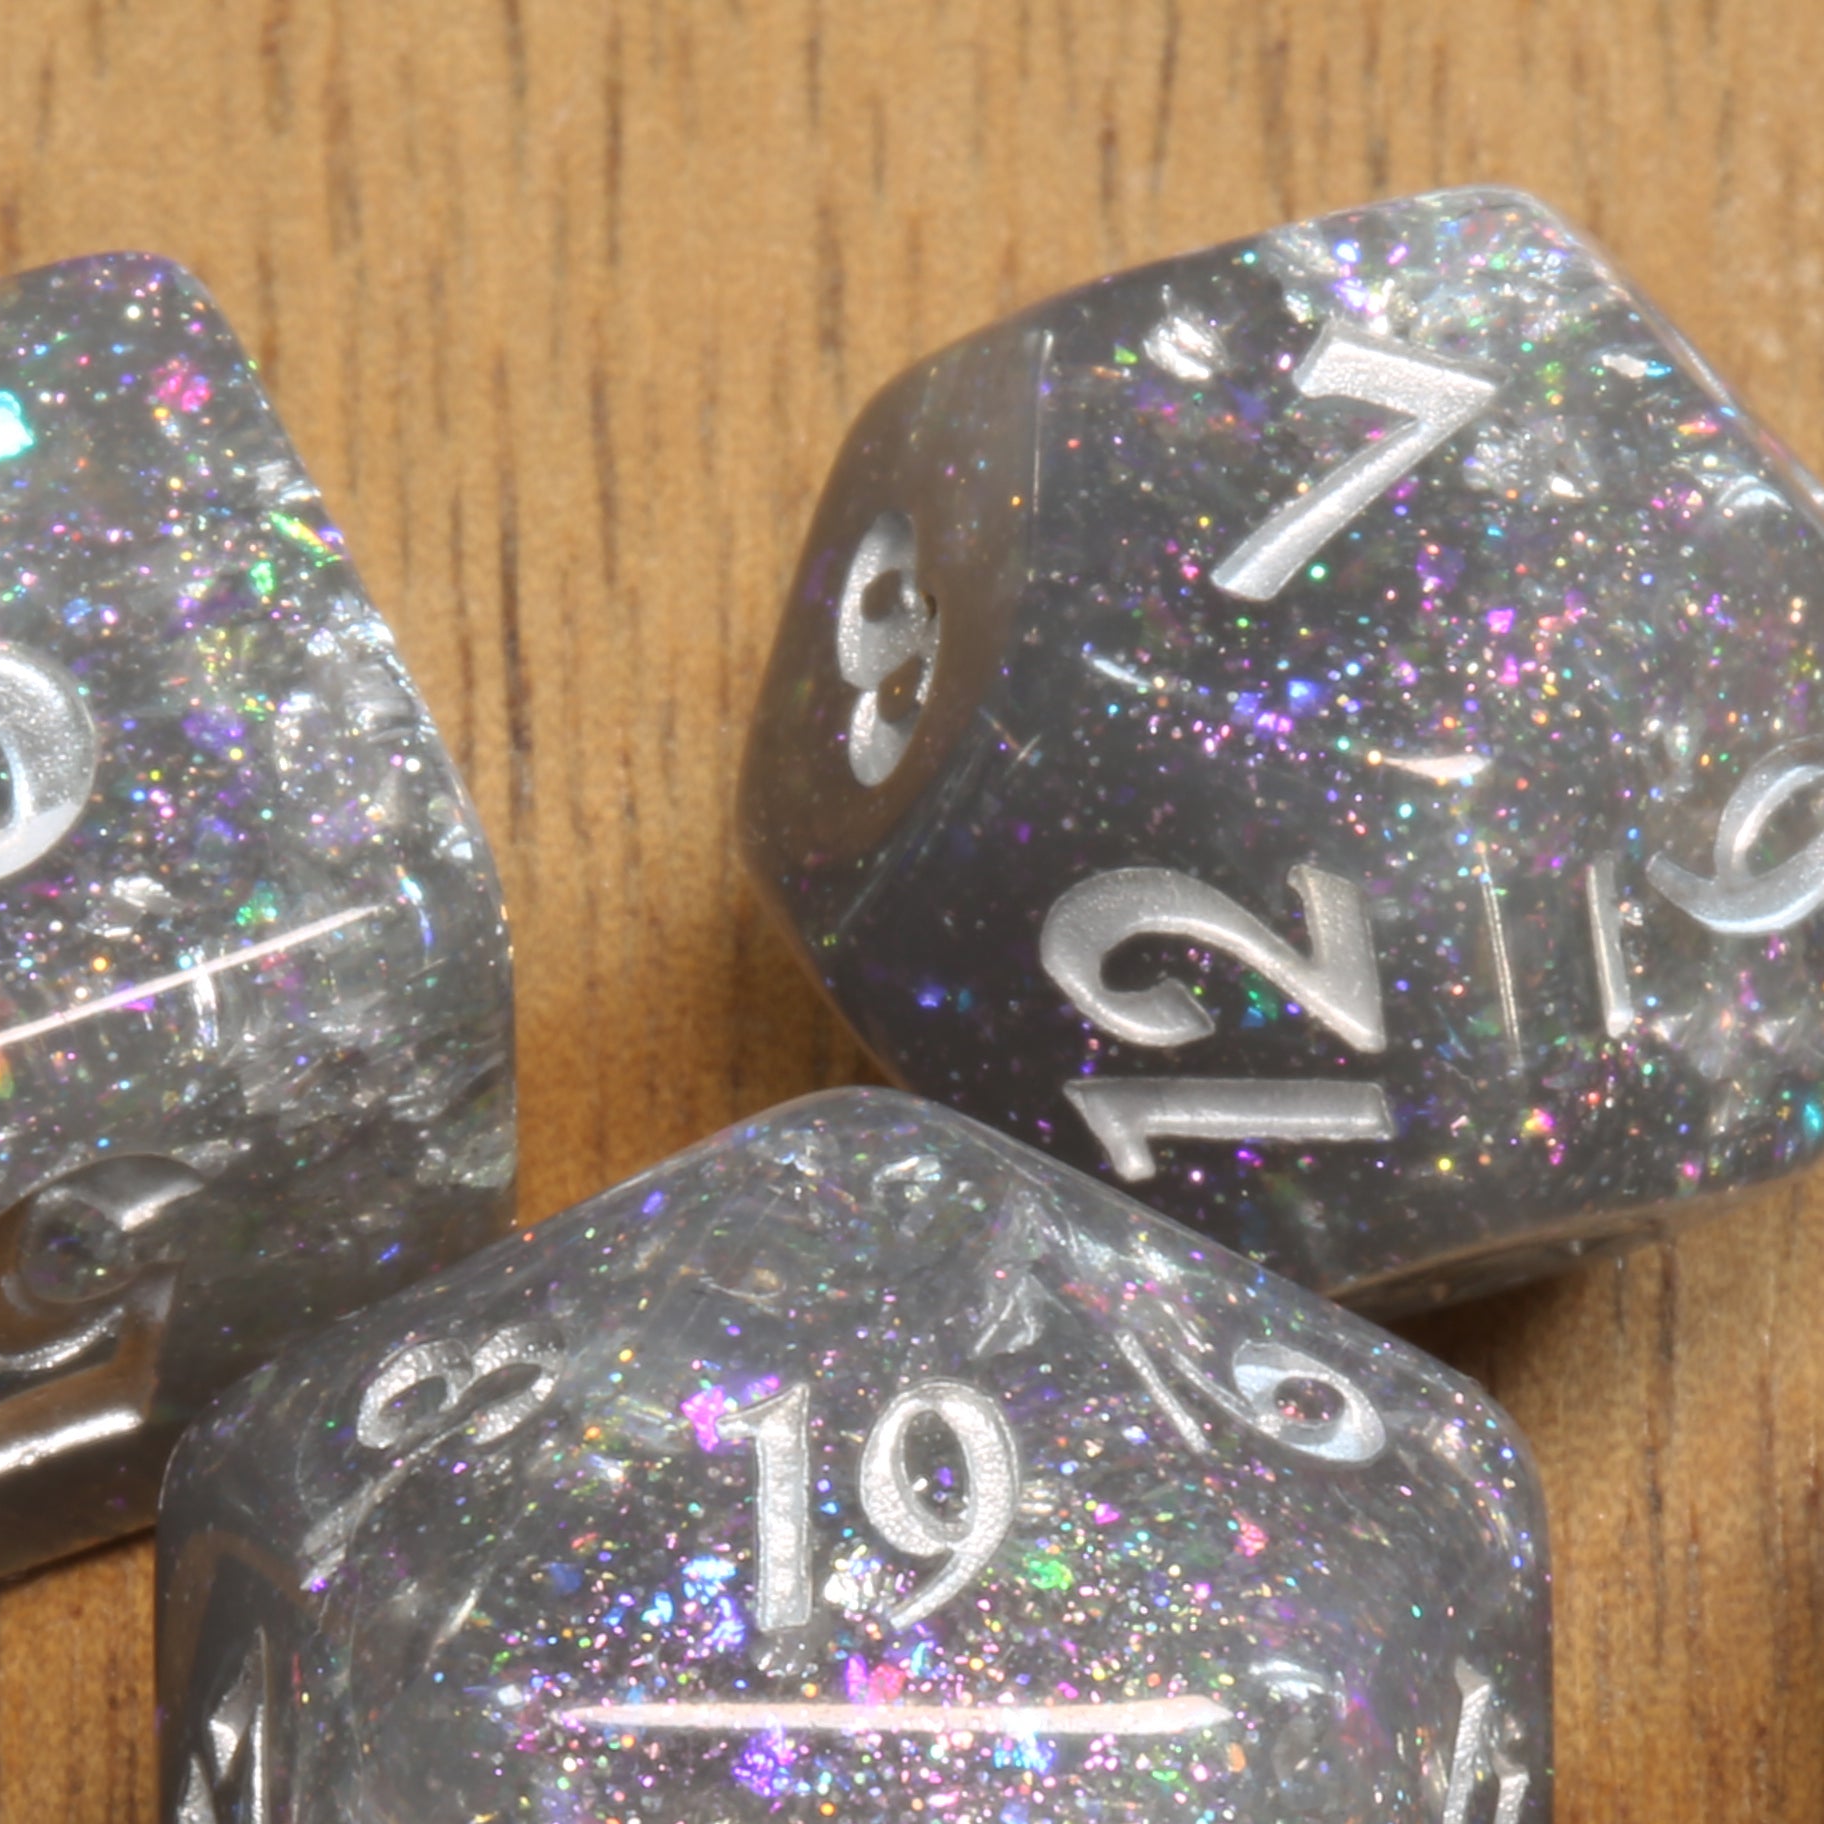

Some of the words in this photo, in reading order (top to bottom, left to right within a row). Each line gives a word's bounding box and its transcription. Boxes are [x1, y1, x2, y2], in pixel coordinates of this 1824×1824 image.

[1210, 320, 1501, 601] 7
[837, 510, 942, 788] 8
[1038, 864, 1395, 1184] 12
[714, 1377, 1024, 1634] 19
